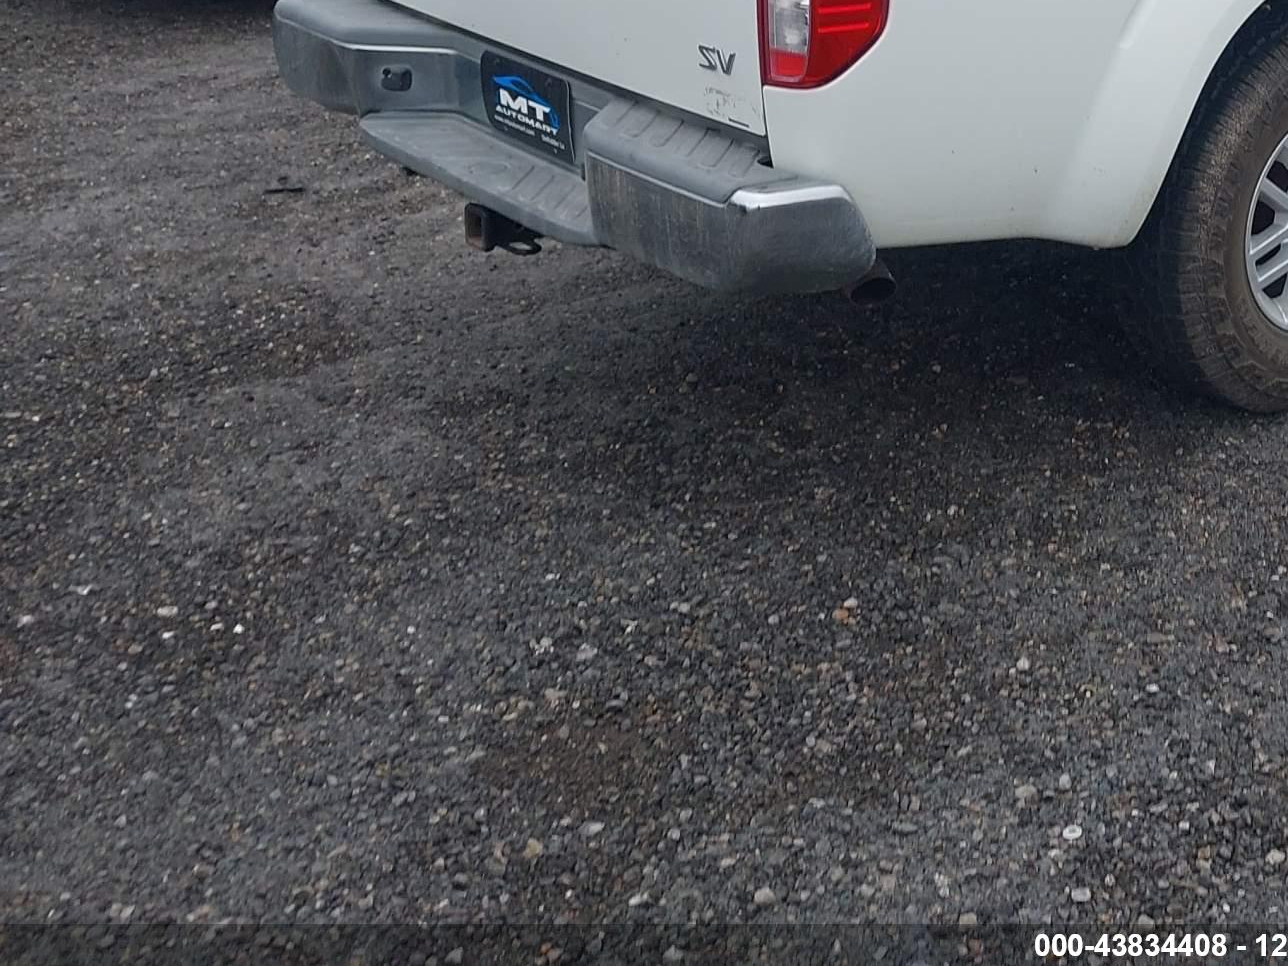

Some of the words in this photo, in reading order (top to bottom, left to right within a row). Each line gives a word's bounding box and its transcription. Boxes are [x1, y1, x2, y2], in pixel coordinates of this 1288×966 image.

[698, 44, 736, 76] SV
[499, 87, 551, 121] MT
[495, 105, 559, 136] AUTOMART
